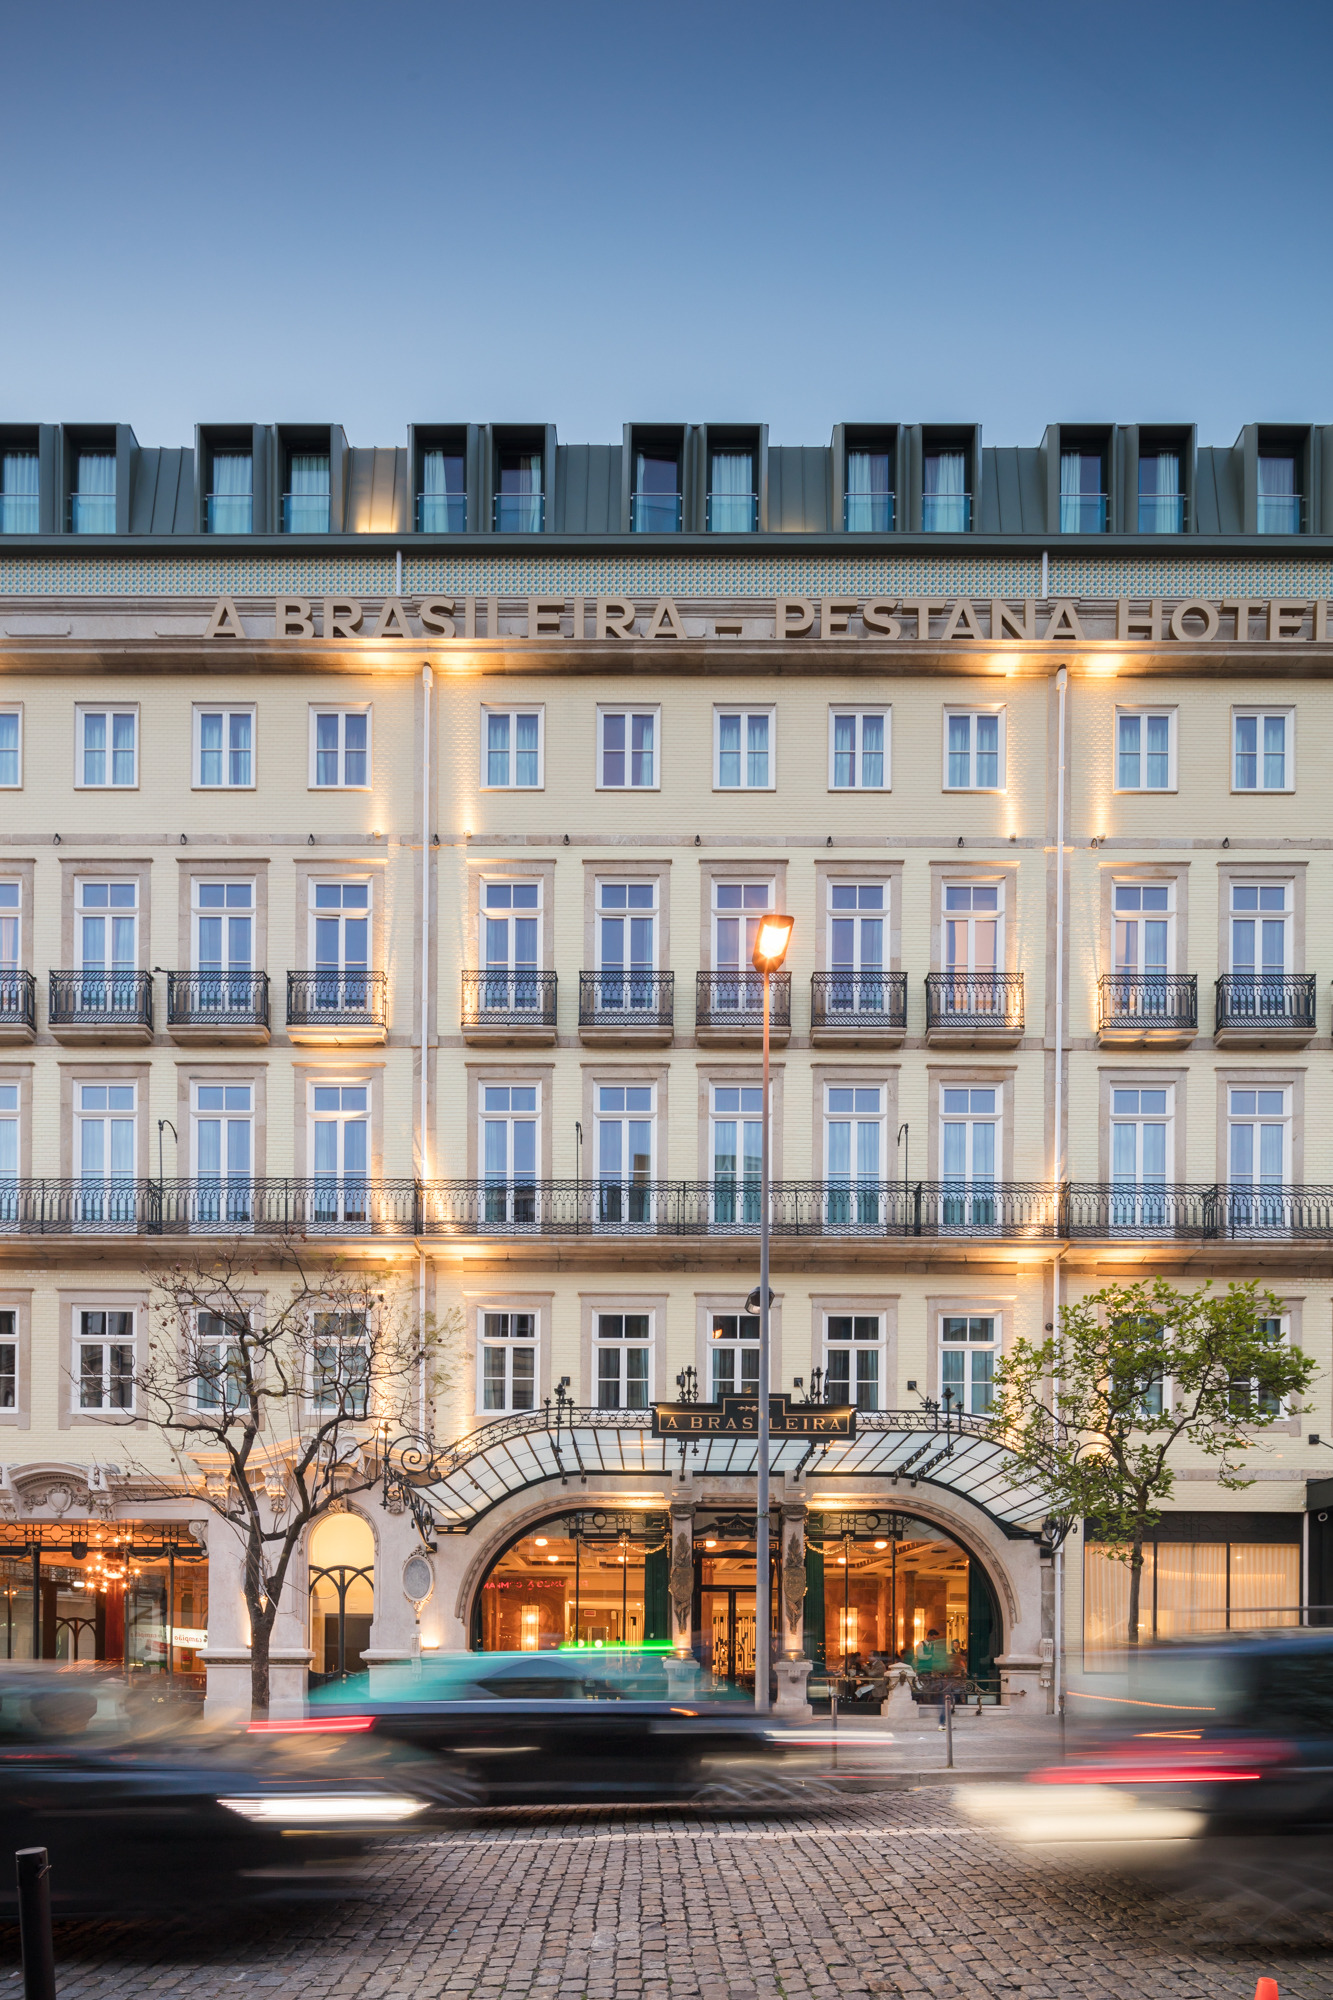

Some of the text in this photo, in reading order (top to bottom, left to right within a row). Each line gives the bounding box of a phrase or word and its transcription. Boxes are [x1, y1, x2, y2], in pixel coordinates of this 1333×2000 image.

[203, 597, 246, 638] A
[275, 597, 688, 638] BRASILEIRA
[775, 597, 1086, 639] PESTANA
[667, 1417, 841, 1430] A BRASLEIRA
